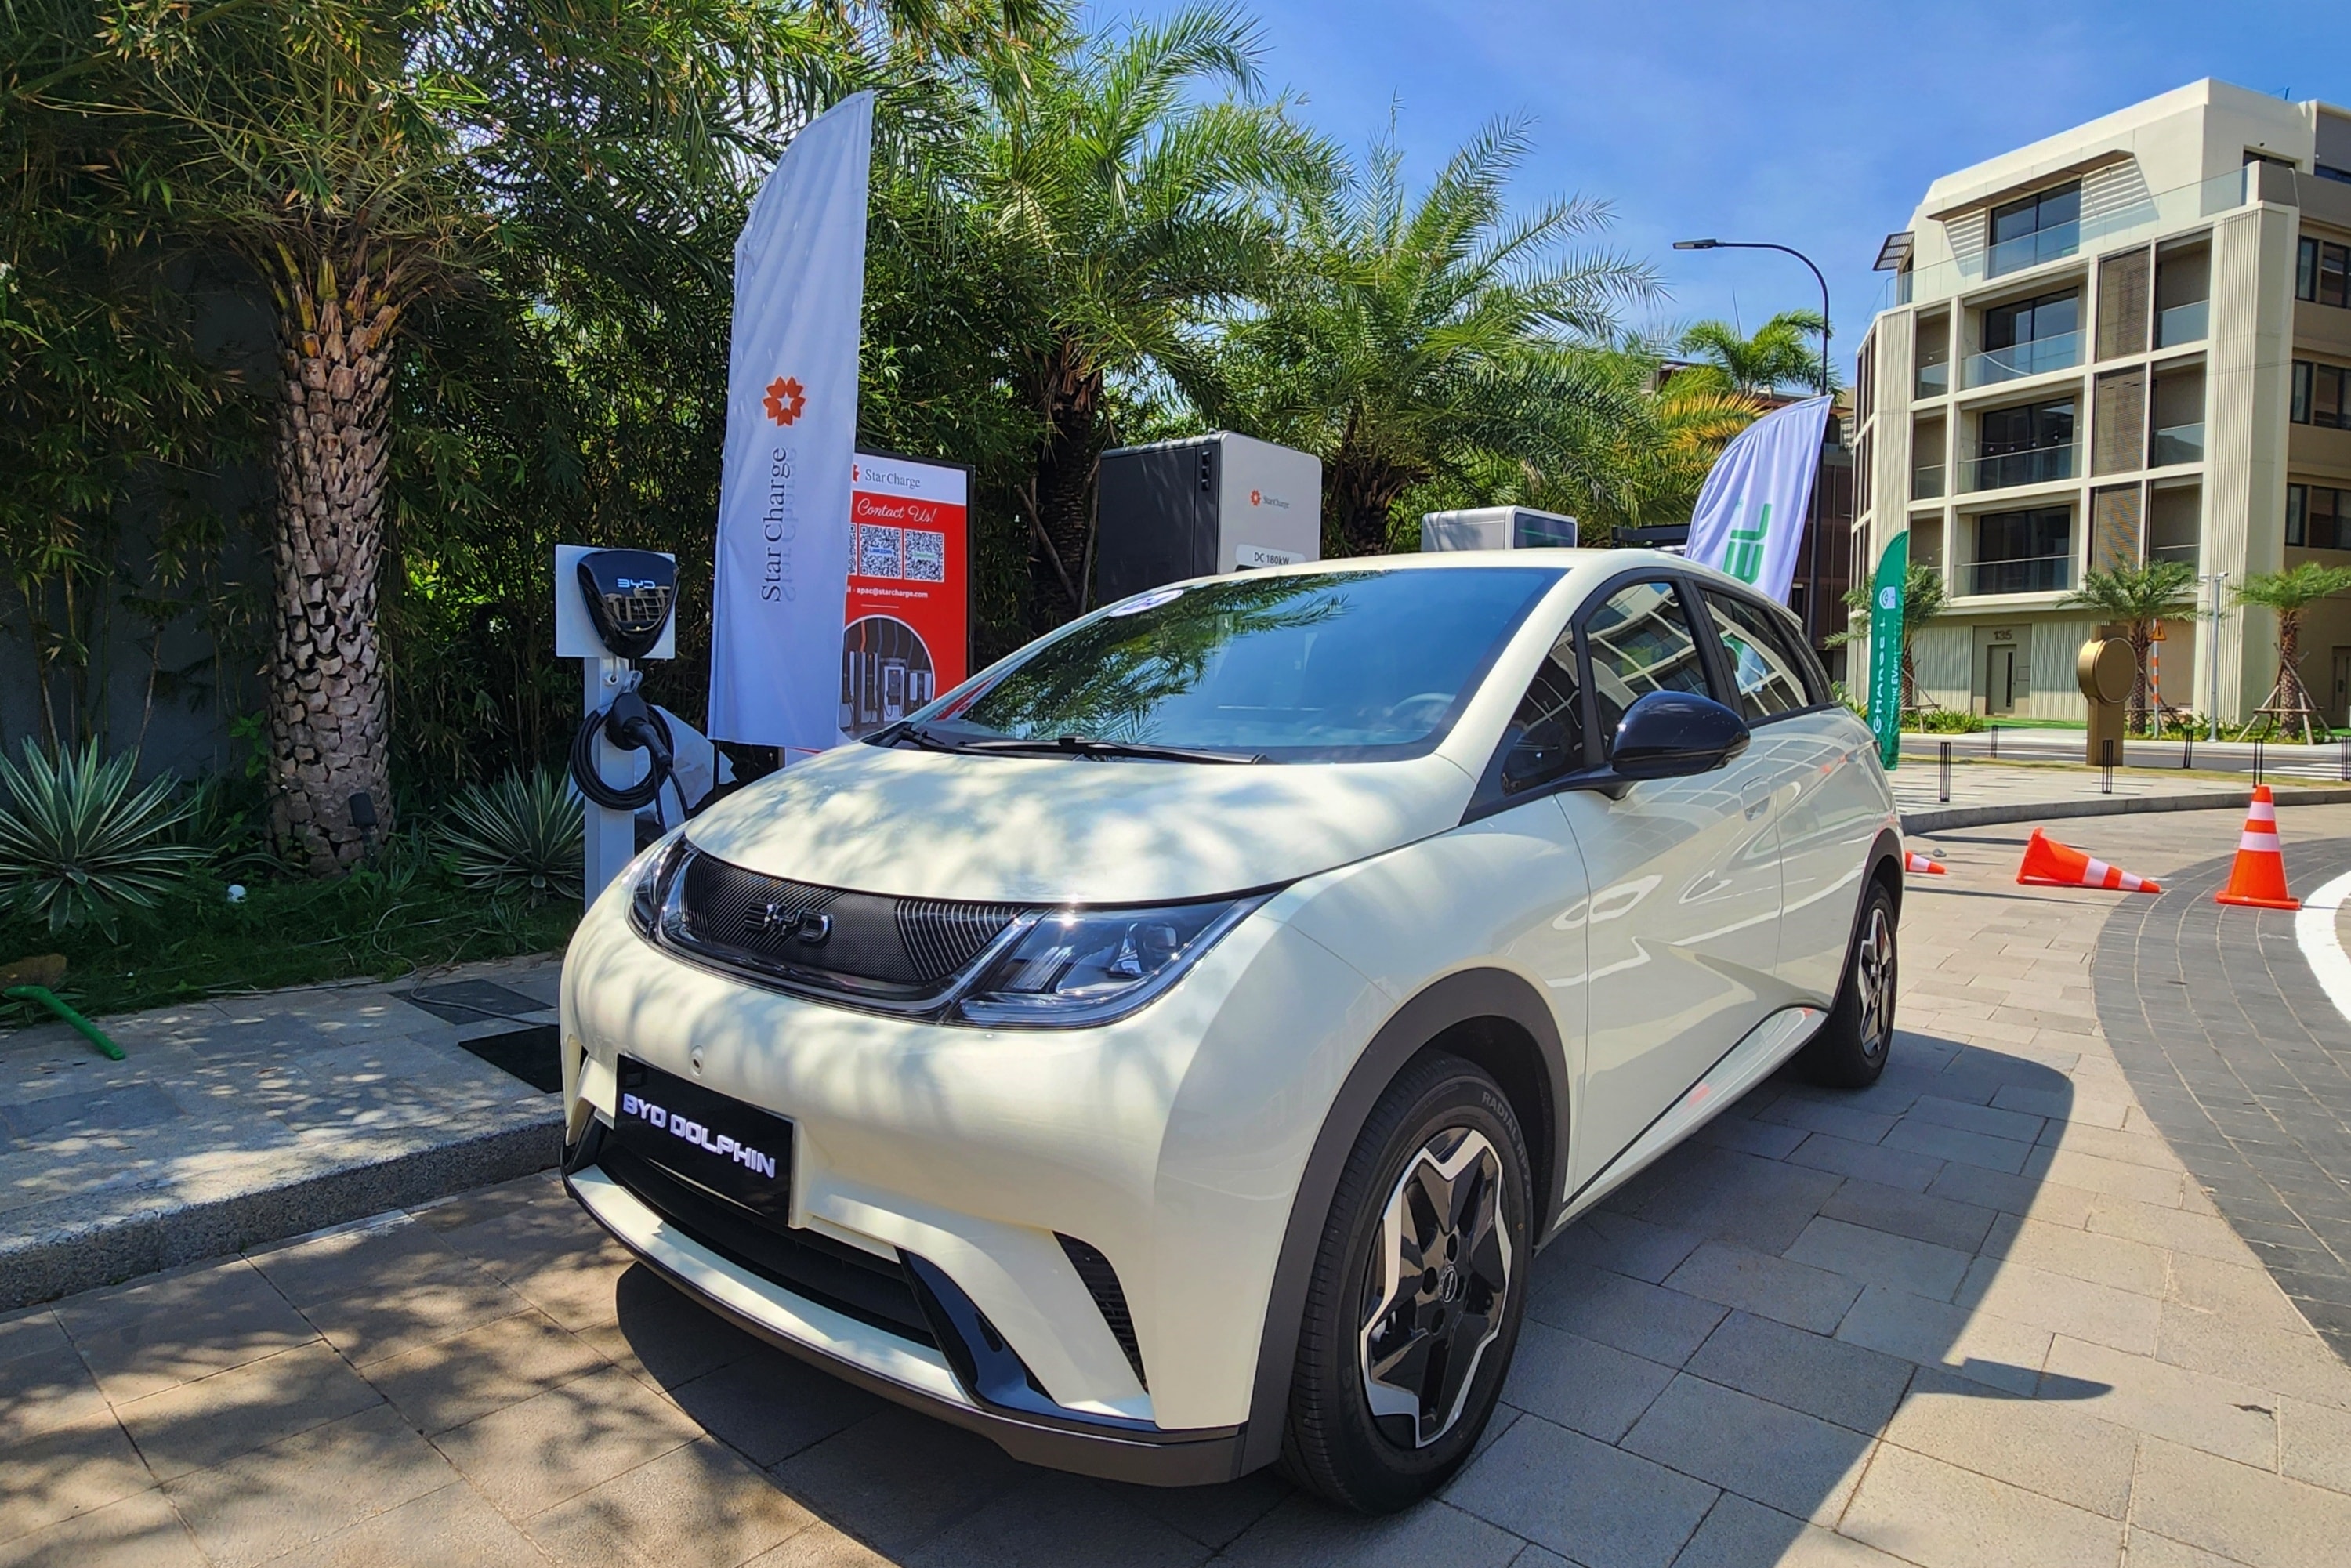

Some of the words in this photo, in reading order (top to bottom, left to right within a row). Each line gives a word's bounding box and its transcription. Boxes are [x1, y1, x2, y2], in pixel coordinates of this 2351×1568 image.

[865, 469, 886, 483] Star
[886, 473, 921, 489] Charge
[763, 447, 790, 542] Charge
[857, 498, 904, 519] Contact
[908, 505, 937, 523] Us!
[1254, 552, 1265, 563] DC
[1266, 553, 1289, 565] 180kW
[617, 578, 656, 589] BYD
[761, 547, 783, 603] Star
[857, 587, 929, 598] apac@starcharge.com
[1993, 629, 2013, 641] 135
[1481, 1091, 1518, 1142] RADIAL
[623, 1093, 666, 1128] BYD
[670, 1114, 775, 1179] DOLPHIN
